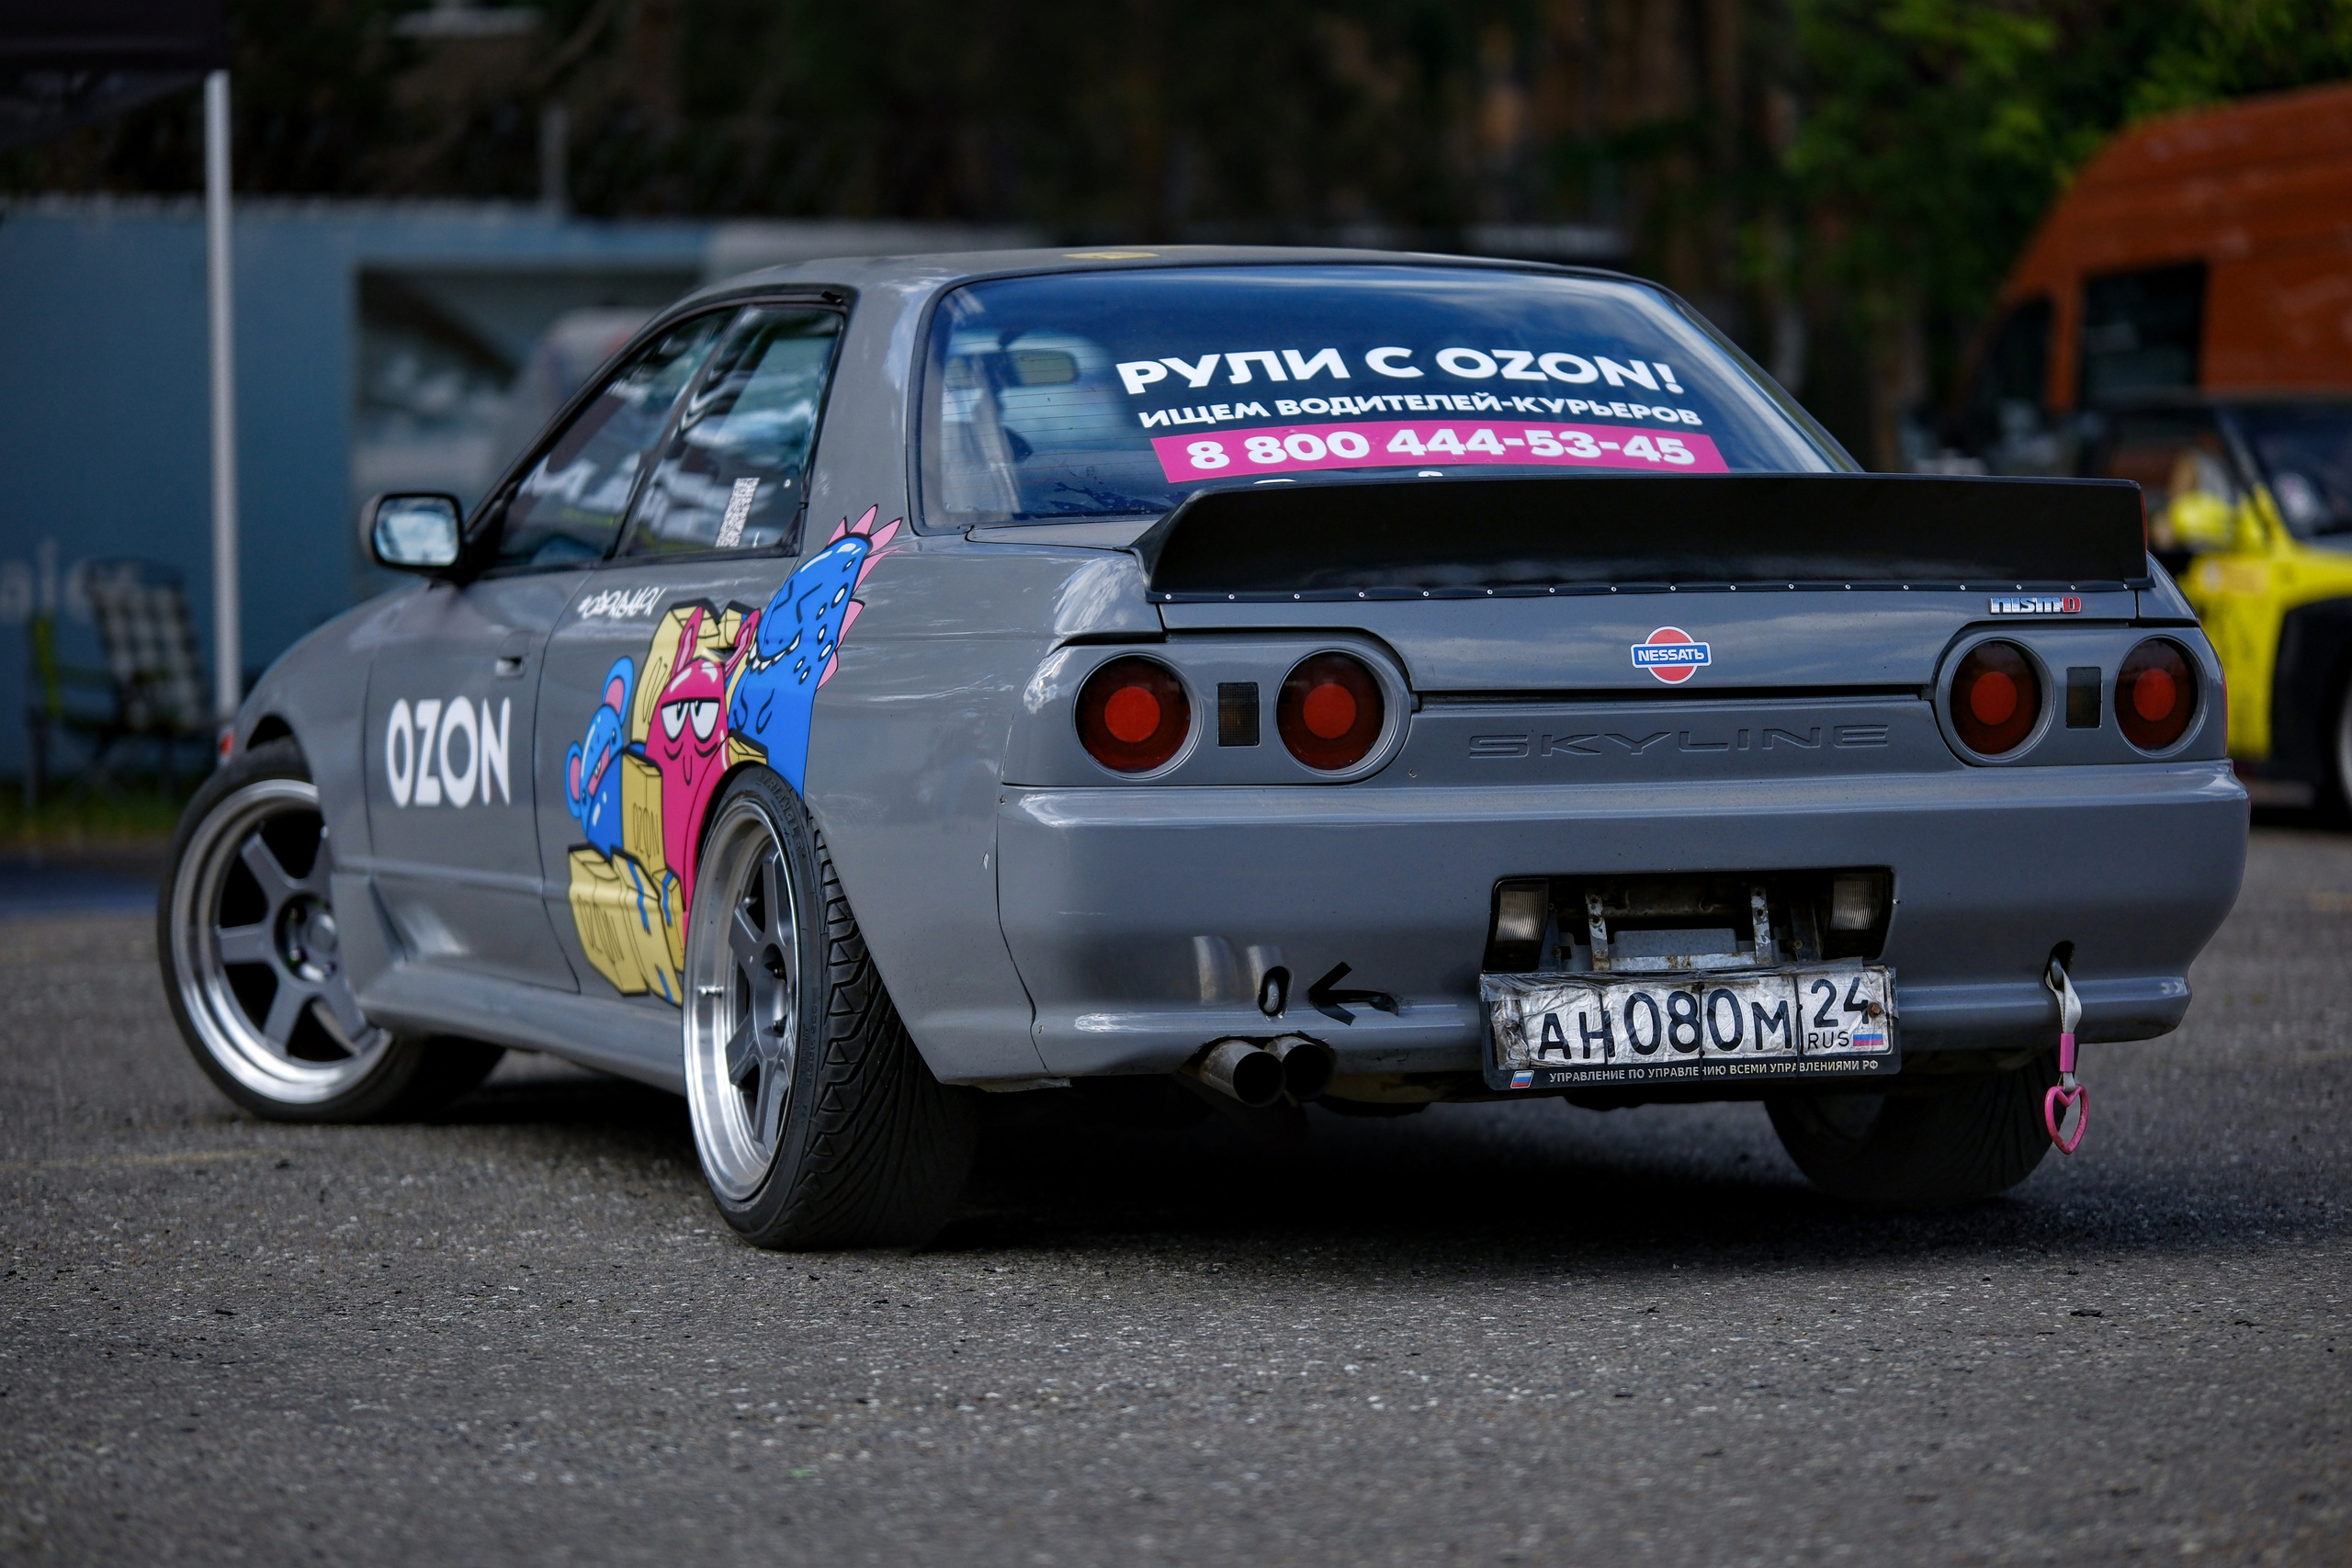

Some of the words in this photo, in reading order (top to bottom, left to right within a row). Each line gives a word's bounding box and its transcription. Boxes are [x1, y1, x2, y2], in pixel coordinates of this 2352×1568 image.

[1114, 347, 1351, 395] РУЛИ
[1365, 346, 1425, 378] С
[1436, 346, 1684, 394] OZON!
[1137, 400, 1272, 429] ИЩЕМ
[1273, 392, 1702, 426] ВОДИТЕЛЕЙ-КУРЬЕРОВ
[1186, 440, 1231, 469] 8
[1243, 430, 1372, 465] 800
[1385, 428, 1696, 466] 444-53-45
[386, 695, 512, 808] OZON
[1469, 724, 1889, 759] SKYLINE
[1810, 976, 1869, 1028] 24
[1807, 1031, 1849, 1050] RUS
[1549, 1068, 1625, 1083] УПРАВЛЕНИЕ
[1628, 1068, 1645, 1079] ПО
[1729, 1063, 1767, 1075] ВСЕМИ
[1770, 1059, 1860, 1073] УПРАВЛЕНИЯМИ
[1862, 1059, 1879, 1071] РФ
